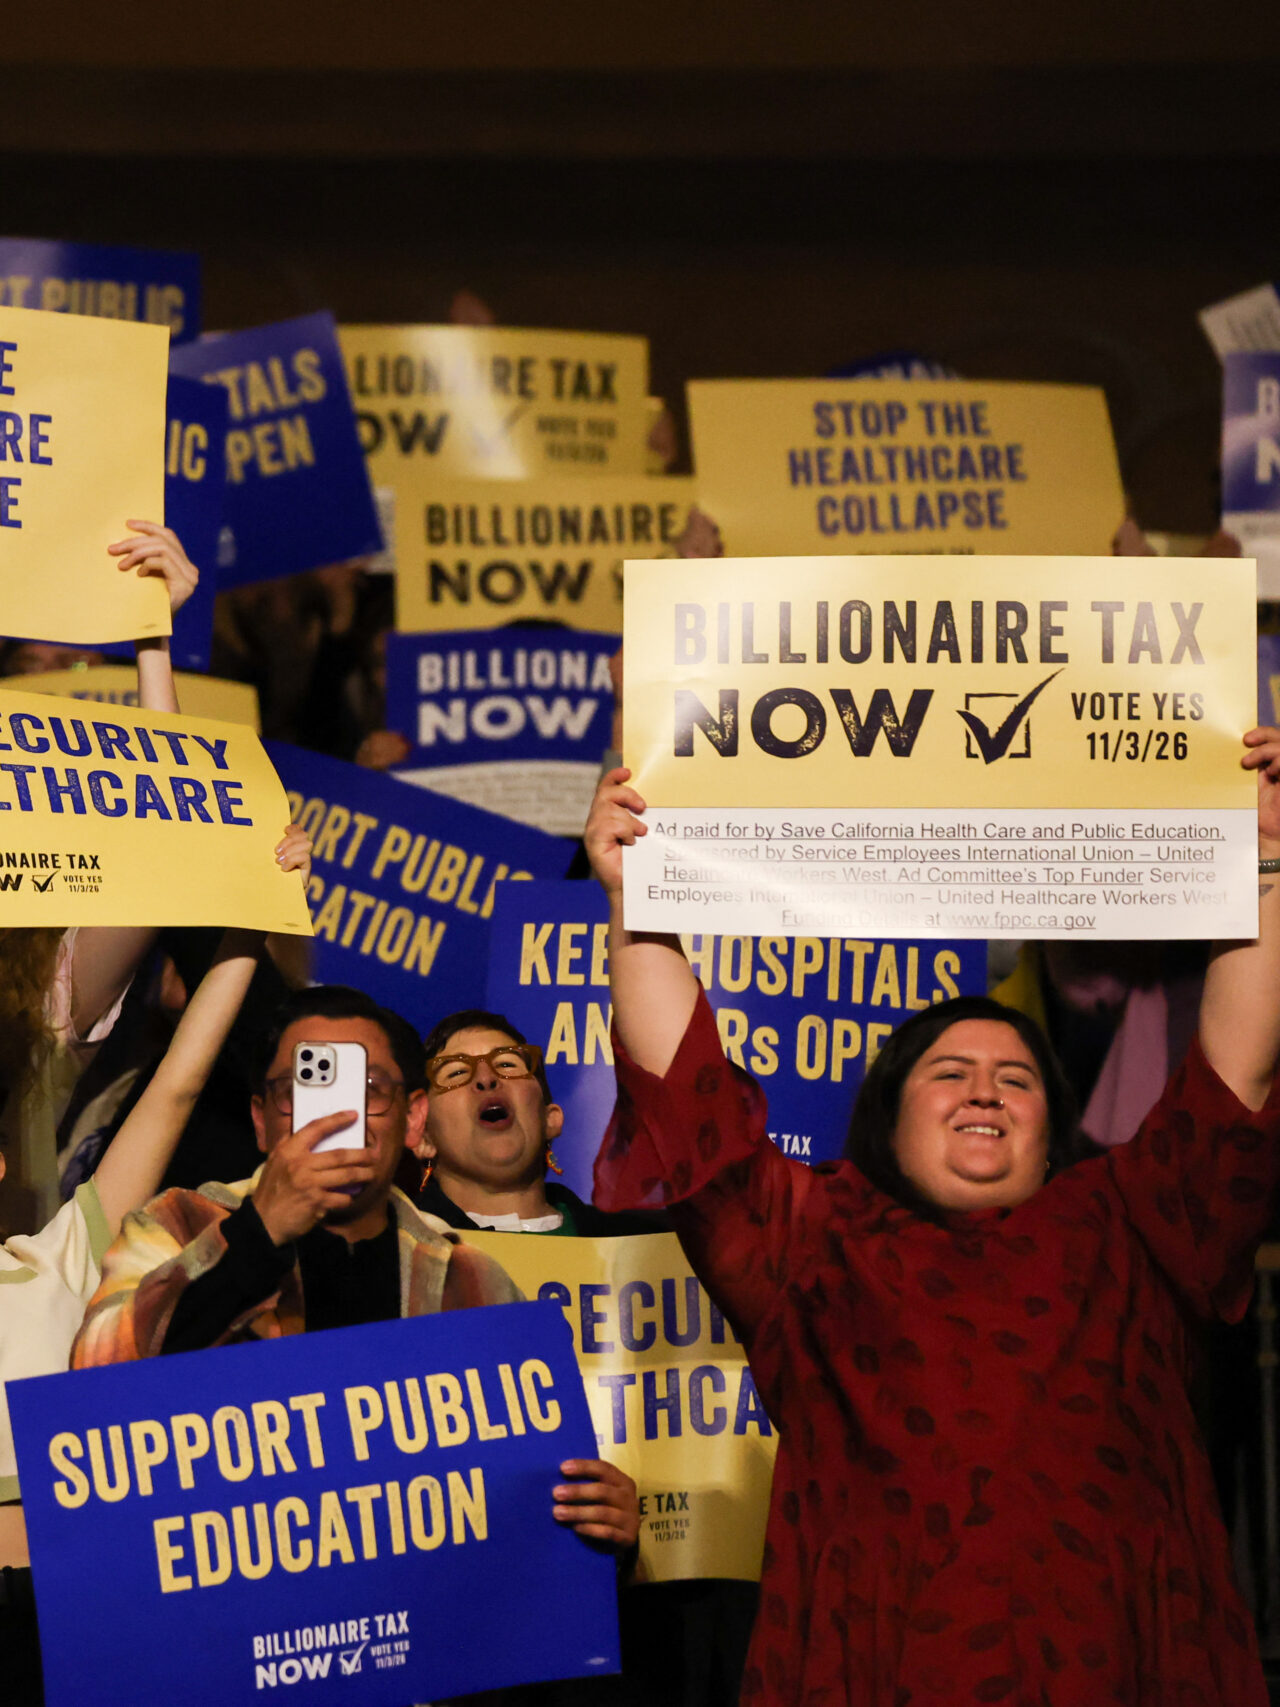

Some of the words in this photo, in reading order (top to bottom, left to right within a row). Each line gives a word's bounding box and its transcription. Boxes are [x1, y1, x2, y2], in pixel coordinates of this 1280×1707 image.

[549, 356, 617, 402] TAX
[356, 408, 450, 456] OW
[813, 400, 908, 439] STOP
[922, 400, 990, 438] THE
[788, 443, 1028, 487] HEALTHCARE
[425, 503, 676, 547] BILLIONAIRE
[817, 489, 1007, 535] COLLAPSE
[427, 558, 592, 605] NOW
[673, 599, 1069, 666] BILLIONAIRE
[1091, 600, 1206, 666] TAX
[416, 648, 614, 694] BILLIONA
[417, 696, 599, 746] NOW
[673, 687, 935, 759] NOW
[1071, 692, 1142, 722] VOTE
[1154, 692, 1206, 722] YES
[1086, 730, 1189, 763] 11/3/26
[655, 823, 677, 838] Ad
[683, 822, 720, 841] paid
[725, 822, 747, 838] for
[755, 822, 775, 842] by
[781, 823, 825, 839] Save
[831, 822, 915, 839] California
[921, 823, 978, 839] Health
[983, 823, 1027, 840] Care
[1032, 823, 1065, 840] and
[1071, 823, 1126, 840] Public
[1131, 823, 1226, 841] Education,
[66, 853, 101, 870] TAX
[370, 825, 535, 919] PUBLI
[765, 845, 787, 864] by
[792, 845, 858, 861] Service
[864, 845, 961, 864] Employees
[968, 845, 1076, 862] International
[1082, 846, 1135, 862] Union
[1157, 846, 1215, 862] United
[63, 875, 84, 883] VOTE
[87, 875, 103, 883] YES
[68, 884, 100, 893] 11/3/26
[648, 885, 744, 905] Employees
[865, 888, 916, 904] Union
[937, 889, 995, 906] United
[1001, 889, 1097, 906] Healthcare
[1102, 889, 1177, 906] Workers
[1182, 890, 1229, 906] West
[897, 866, 921, 882] Ad
[927, 866, 1037, 884] Committee's
[1042, 867, 1075, 886] Top
[1081, 867, 1144, 884] Funder
[1150, 868, 1217, 884] Service
[924, 912, 941, 926] at
[948, 911, 1097, 930] www.fppc.ca.gov
[684, 934, 962, 1011] HOSPITALS
[781, 1133, 812, 1156] TAX
[48, 1392, 326, 1509] SUPPORT
[344, 1358, 563, 1462] PUBLIC
[654, 1491, 690, 1516] TAX
[153, 1467, 489, 1594] EDUCATION
[649, 1519, 671, 1531] VOTE
[673, 1517, 690, 1529] YES
[253, 1618, 370, 1659] BILLIONAIRE
[374, 1611, 410, 1639] TAX
[370, 1644, 393, 1657] VOTE
[394, 1640, 410, 1653] YES
[255, 1652, 333, 1690] NOW
